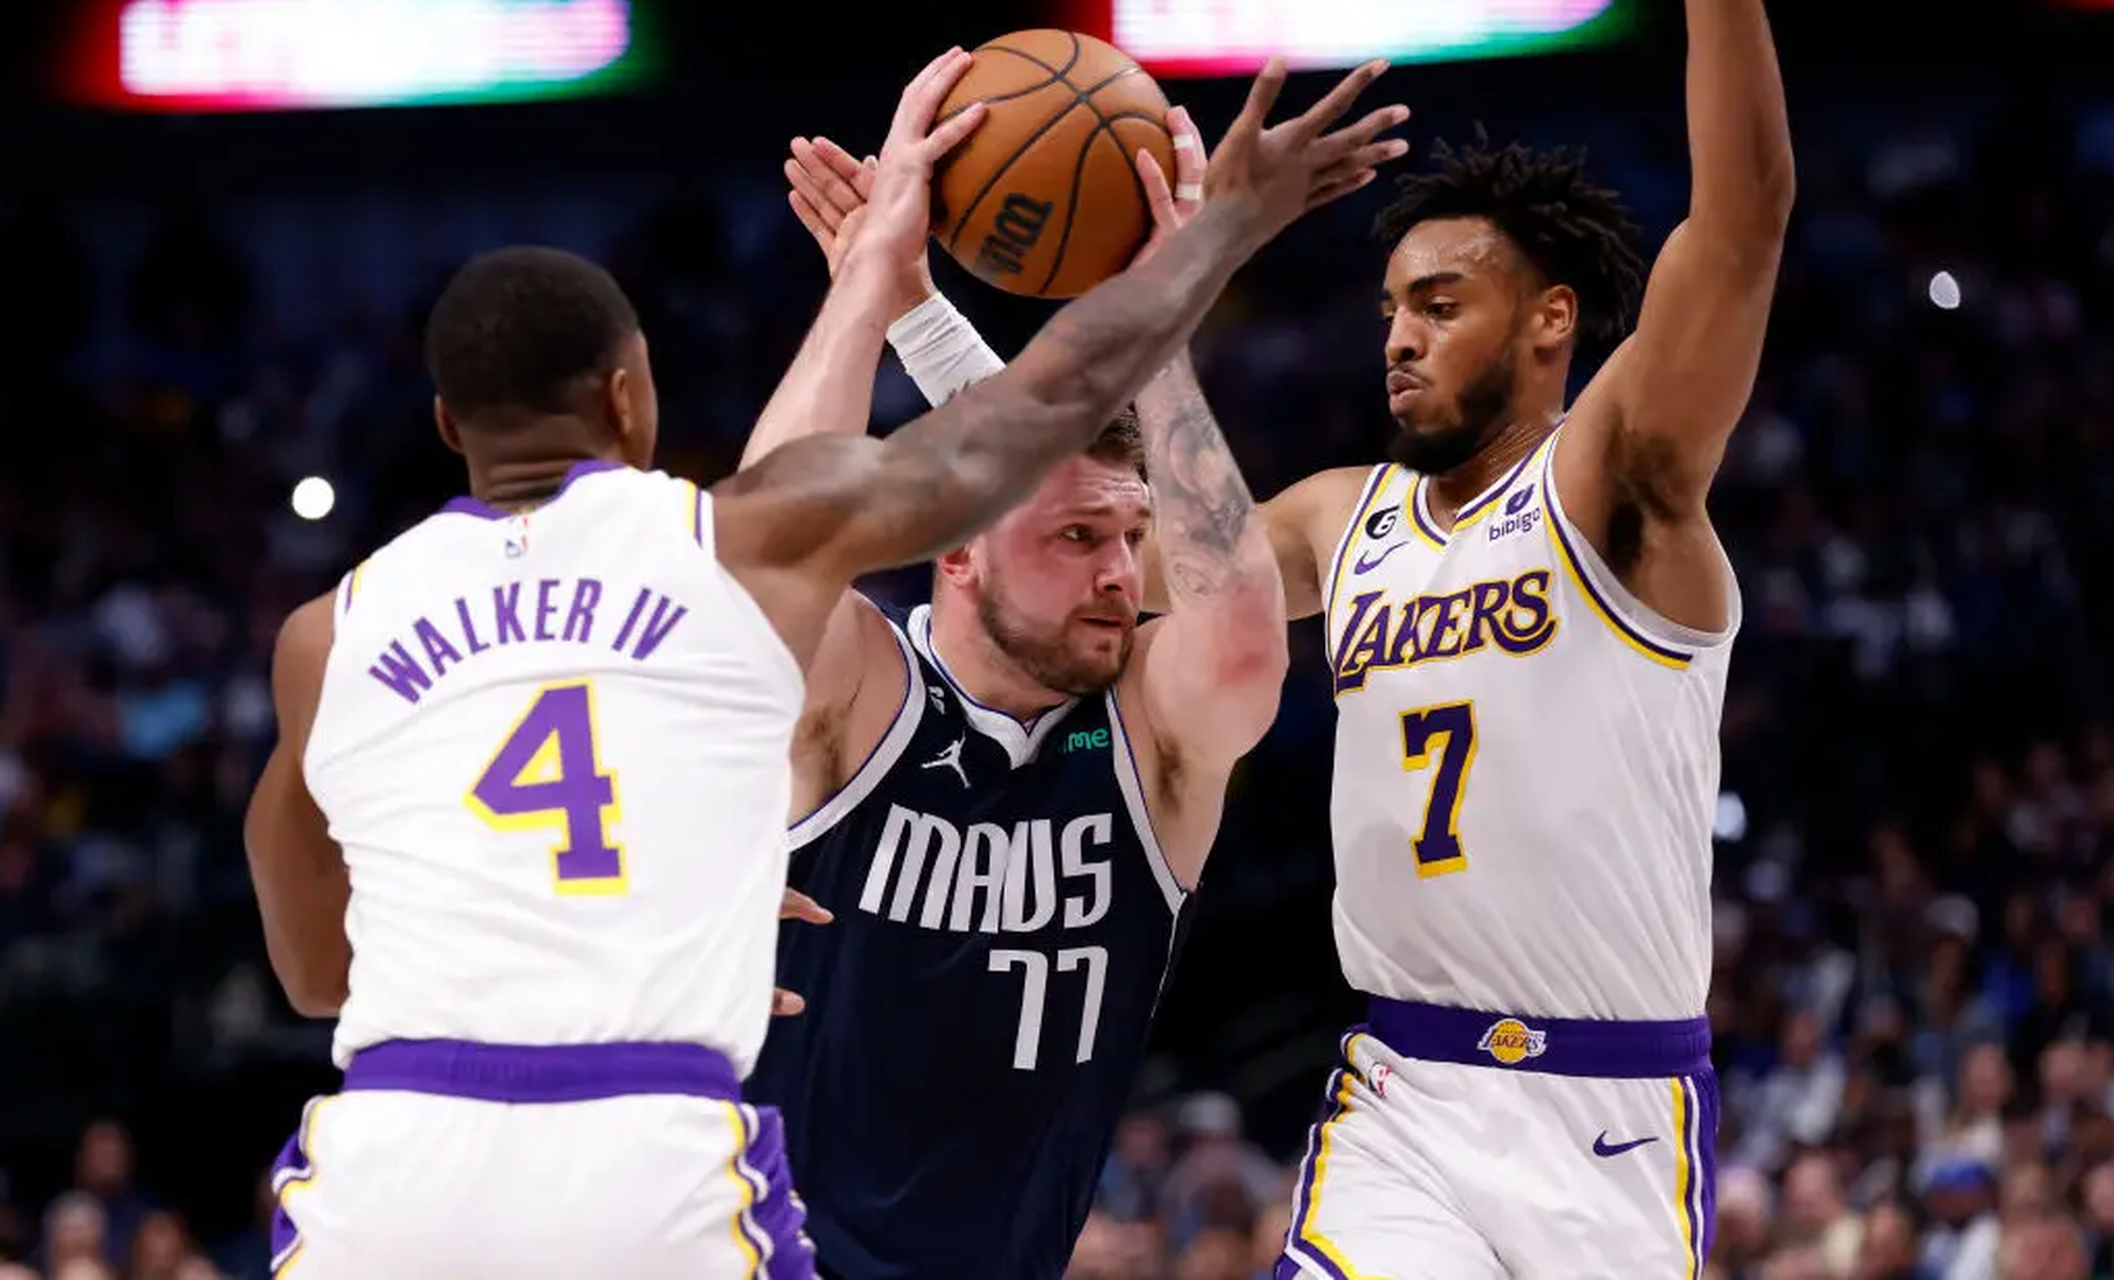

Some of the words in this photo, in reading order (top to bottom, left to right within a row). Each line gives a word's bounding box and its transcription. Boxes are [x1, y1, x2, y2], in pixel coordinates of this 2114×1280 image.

[1489, 507, 1540, 542] bibigo
[369, 578, 602, 704] WALKER
[611, 587, 688, 661] IV
[1335, 571, 1558, 697] LAKERS
[462, 677, 632, 896] 4
[1399, 699, 1478, 879] 7
[858, 803, 1112, 934] MAVS
[987, 945, 1109, 1071] 77
